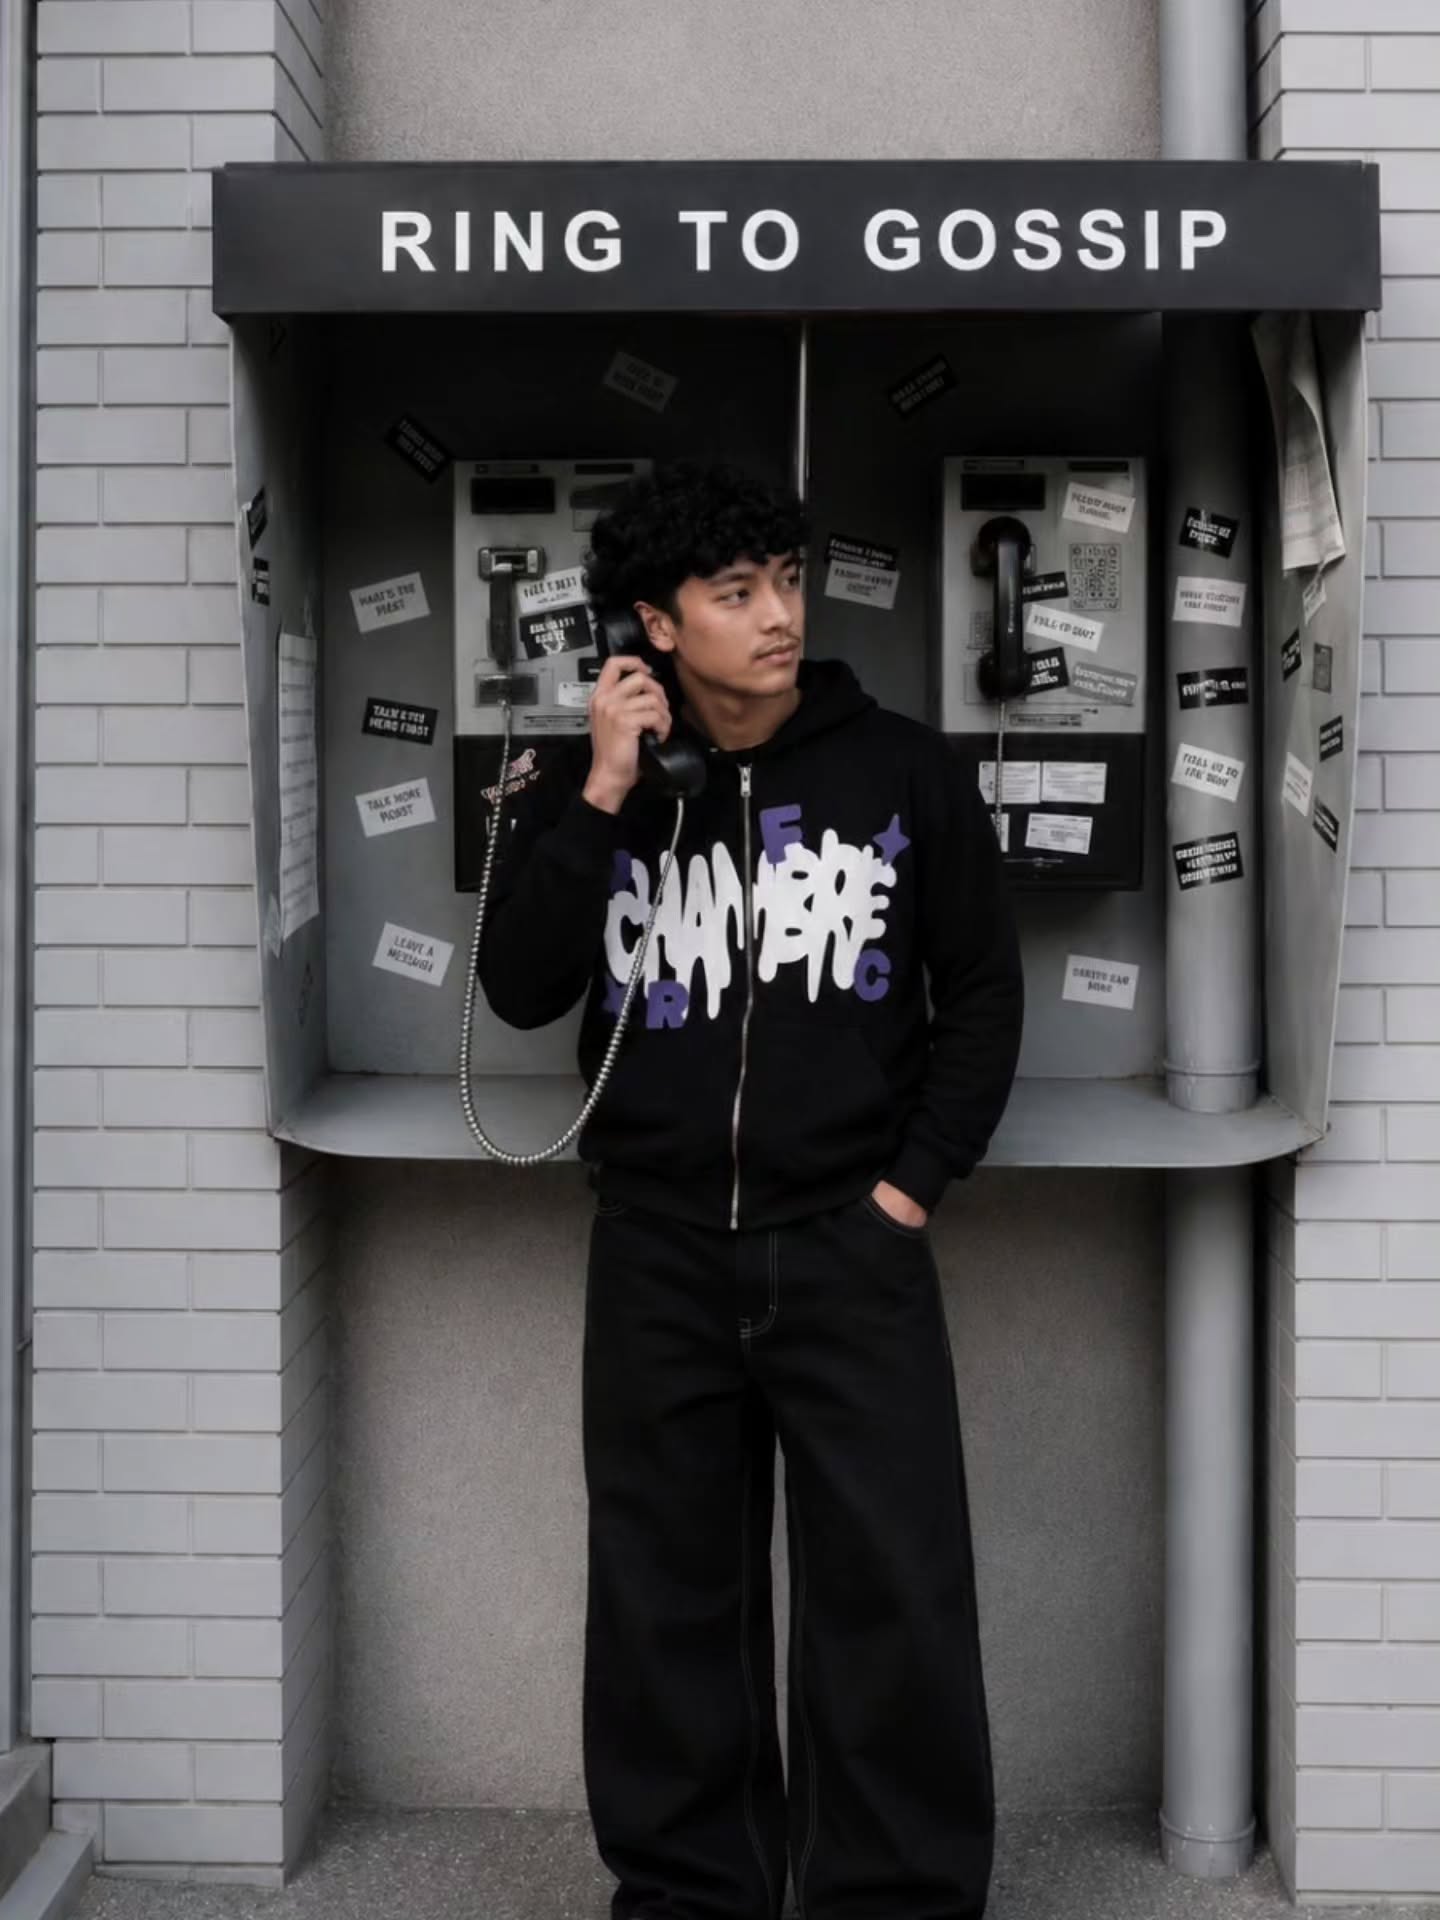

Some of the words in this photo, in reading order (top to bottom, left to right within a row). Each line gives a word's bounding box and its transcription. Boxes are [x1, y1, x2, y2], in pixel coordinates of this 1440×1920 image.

[382, 210, 622, 272] RING
[678, 209, 799, 272] TO
[864, 208, 1227, 271] GOSSIP
[759, 803, 803, 865] F
[426, 946, 434, 957] A
[854, 948, 892, 1002] C
[645, 979, 690, 1029] R
